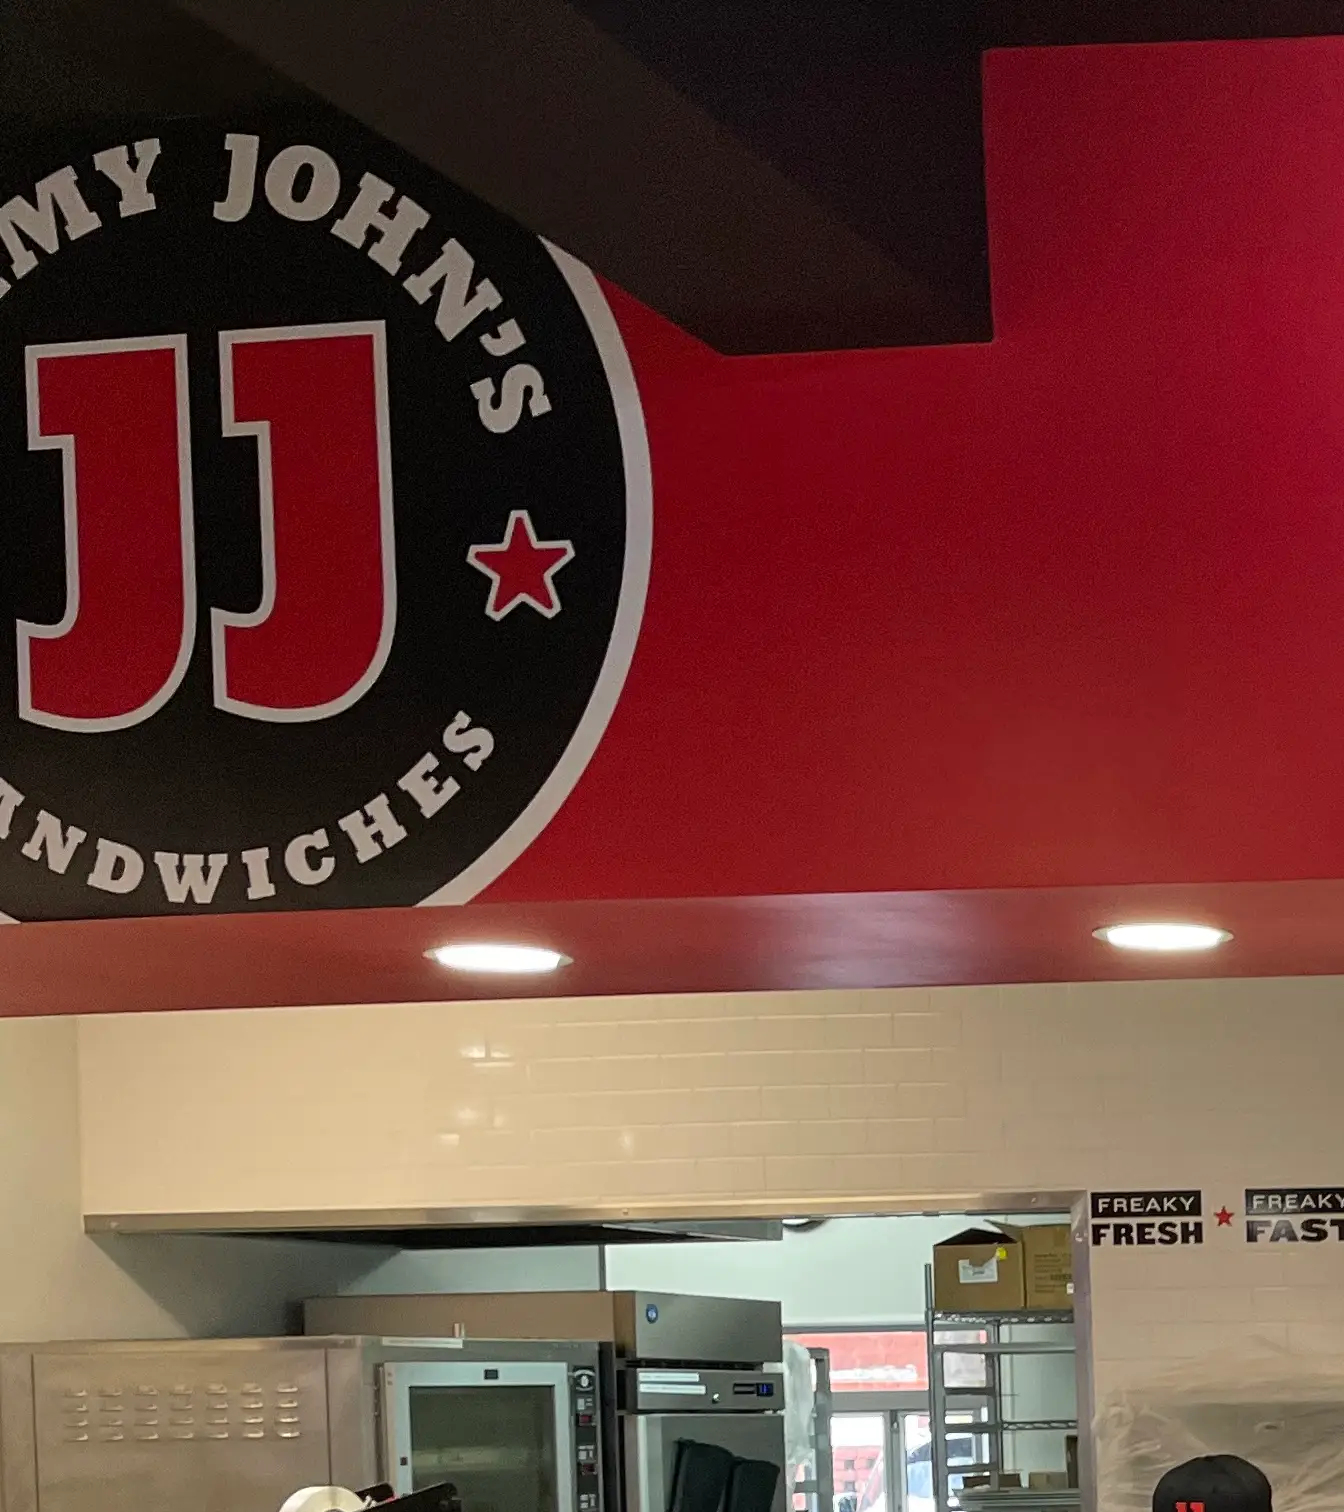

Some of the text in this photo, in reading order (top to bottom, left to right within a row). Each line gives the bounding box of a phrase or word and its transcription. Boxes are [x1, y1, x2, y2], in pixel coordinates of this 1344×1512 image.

[0, 133, 551, 434] MY JOHN'S
[15, 319, 397, 735] JJ
[1092, 1218, 1203, 1245] FRESH
[1098, 1197, 1195, 1212] FREAKY
